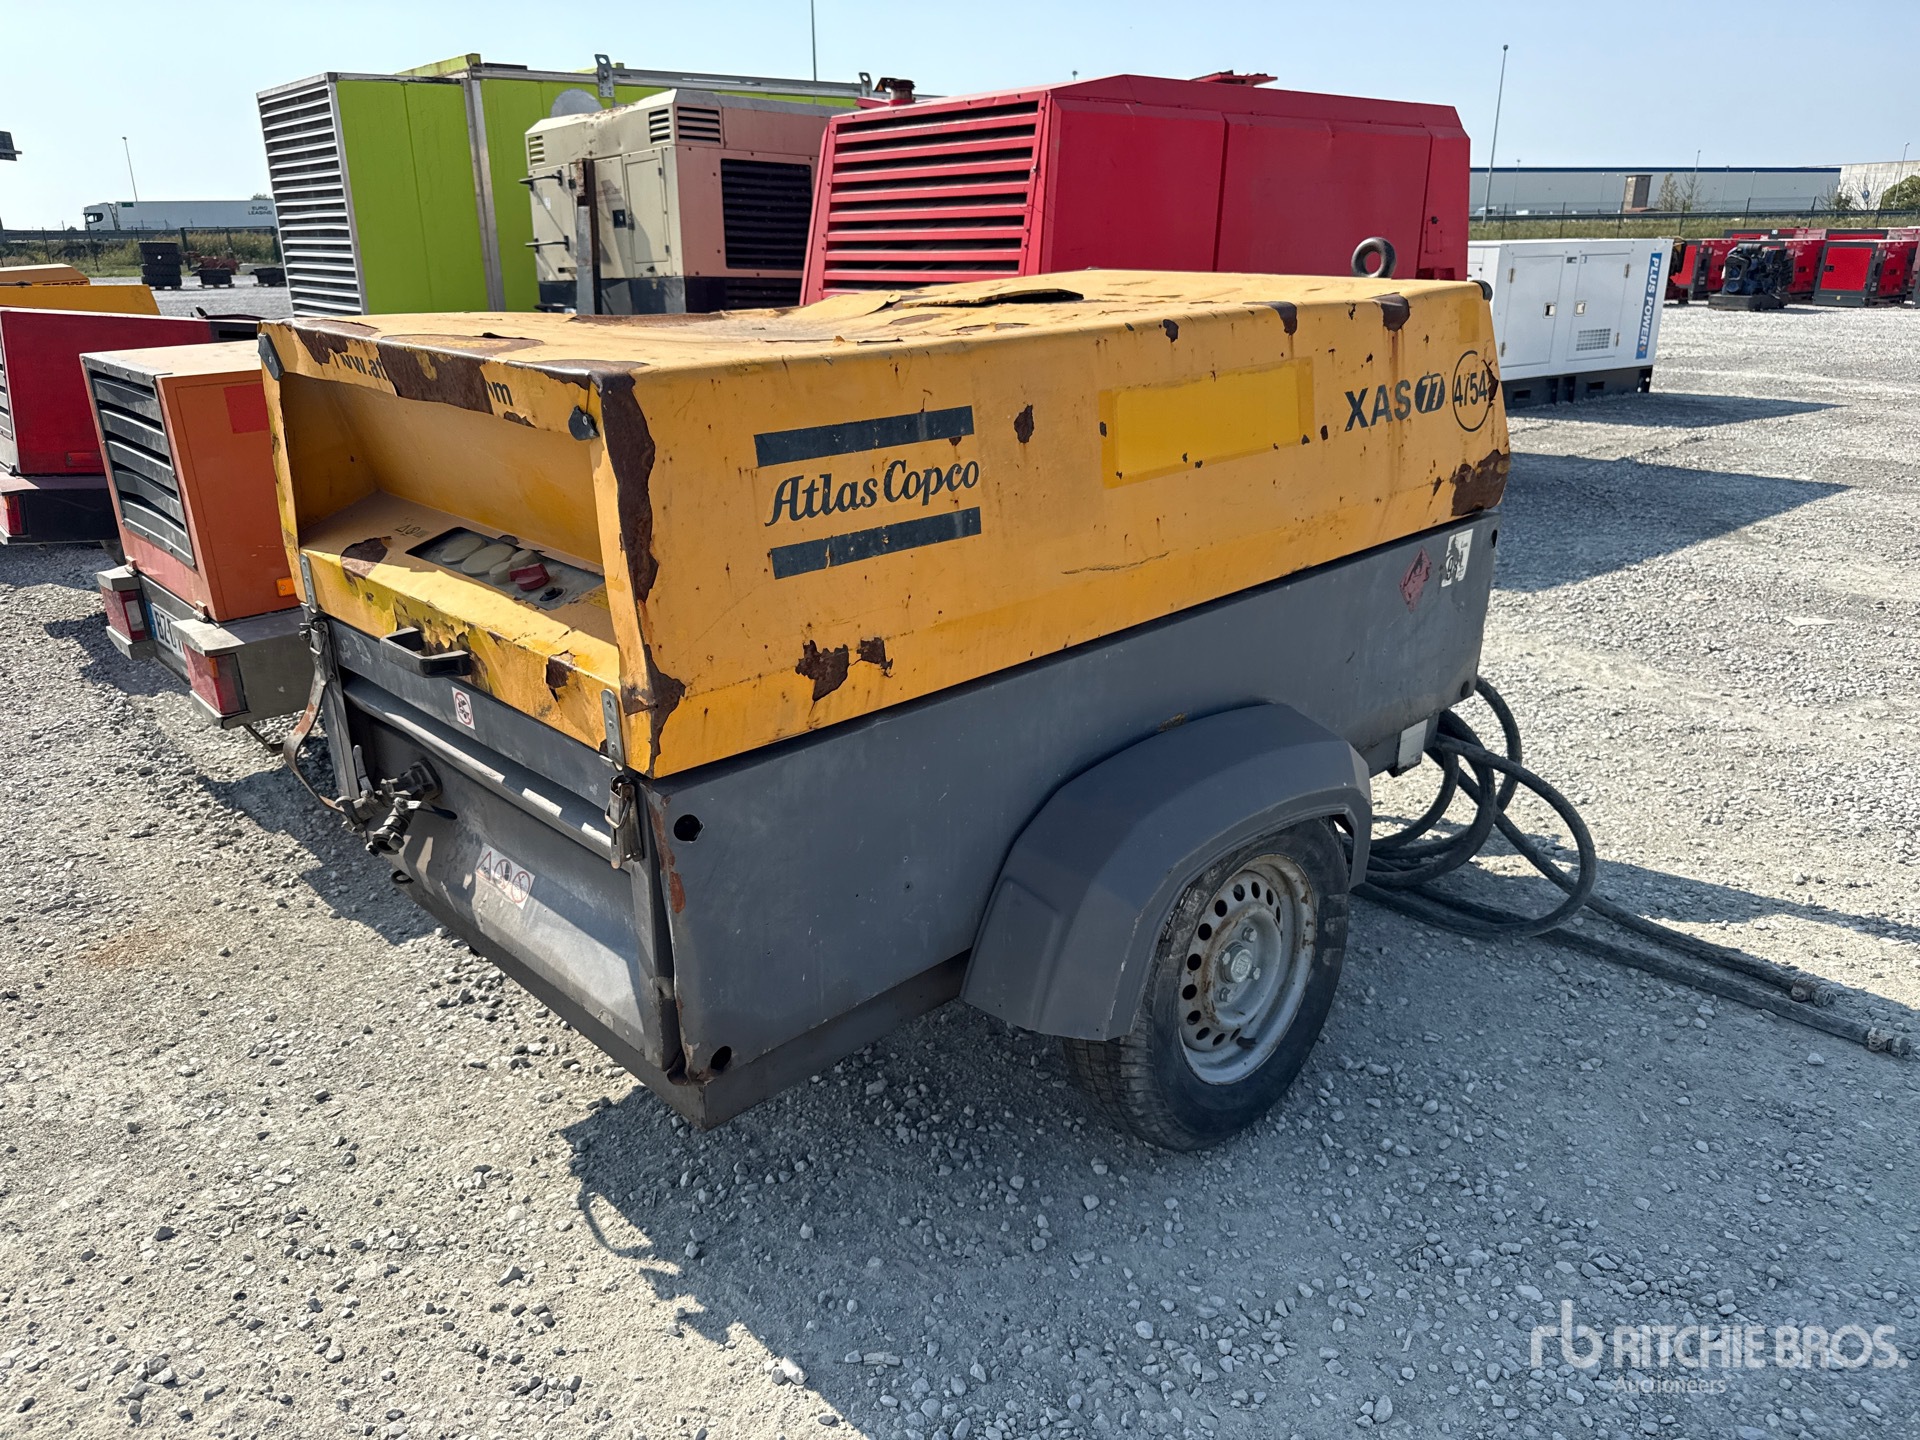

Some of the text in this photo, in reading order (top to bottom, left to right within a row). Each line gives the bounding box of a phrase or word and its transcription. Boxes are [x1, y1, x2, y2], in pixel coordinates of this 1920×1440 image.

[1639, 256, 1660, 346] PLUS POWER
[1344, 378, 1412, 432] XAS
[763, 459, 980, 527] Atlas Copco
